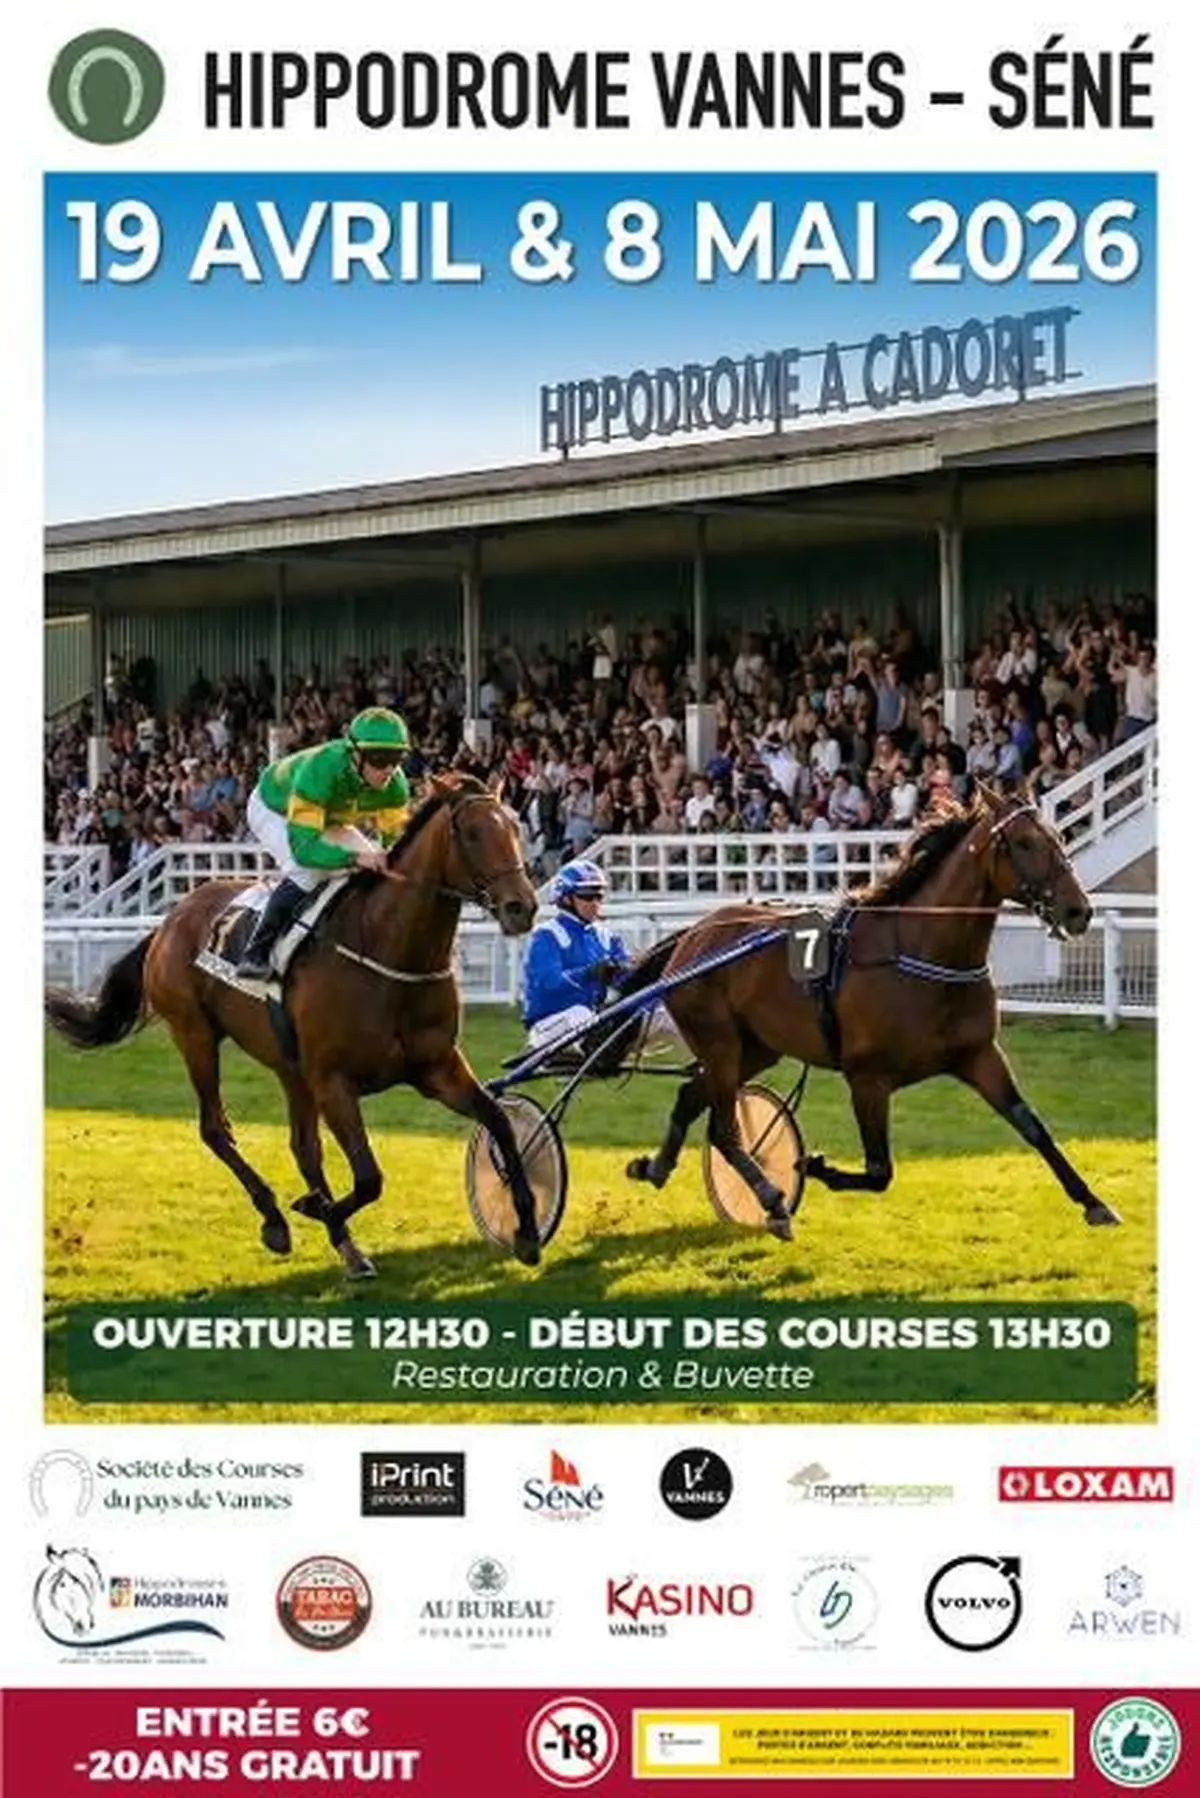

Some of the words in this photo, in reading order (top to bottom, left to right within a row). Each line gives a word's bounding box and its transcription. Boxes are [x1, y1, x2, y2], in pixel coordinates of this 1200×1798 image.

[205, 51, 629, 129] HIPPODROME
[651, 52, 905, 129] VANNES
[989, 34, 1153, 129] SÉNÉ
[67, 200, 161, 283] 19
[190, 200, 483, 283] AVRIL
[511, 200, 575, 283] &
[605, 200, 663, 283] 8
[696, 200, 876, 283] MAI
[908, 200, 1140, 283] 2026
[541, 347, 801, 451] HIPPODROME
[820, 341, 848, 414] A
[862, 306, 1075, 408] CADORET
[795, 929, 819, 969] 7
[93, 1318, 353, 1348] OUVERTURE
[365, 1318, 489, 1348] 12H30
[530, 1310, 671, 1348] DÉBUT
[684, 1318, 768, 1348] DES
[779, 1318, 978, 1348] COURSES
[989, 1318, 1111, 1348] 13H30
[393, 1359, 627, 1389] Restauration
[638, 1361, 662, 1389] &
[674, 1361, 814, 1389] Buvette
[177, 1457, 212, 1478] des
[216, 1459, 304, 1478] Courses
[372, 1463, 454, 1487] iPrint
[665, 1490, 726, 1504] VANNES
[1035, 1470, 1170, 1498] LOXAM
[104, 1489, 131, 1509] du
[135, 1494, 182, 1514] pays
[185, 1489, 212, 1509] de
[216, 1491, 292, 1509] Vannes
[134, 1592, 228, 1609] MORBIHAN
[420, 1600, 451, 1619] AU
[457, 1600, 554, 1619] BUREAU
[607, 1576, 753, 1621] KASINO
[938, 1598, 1011, 1609] VOLVO
[1069, 1611, 1181, 1635] ARWEN
[137, 1699, 300, 1737] ENTRÉE
[313, 1707, 369, 1737] 6€
[543, 1723, 599, 1760] -18
[75, 1750, 228, 1780] -20ANS
[241, 1750, 420, 1780] GRATUIT
